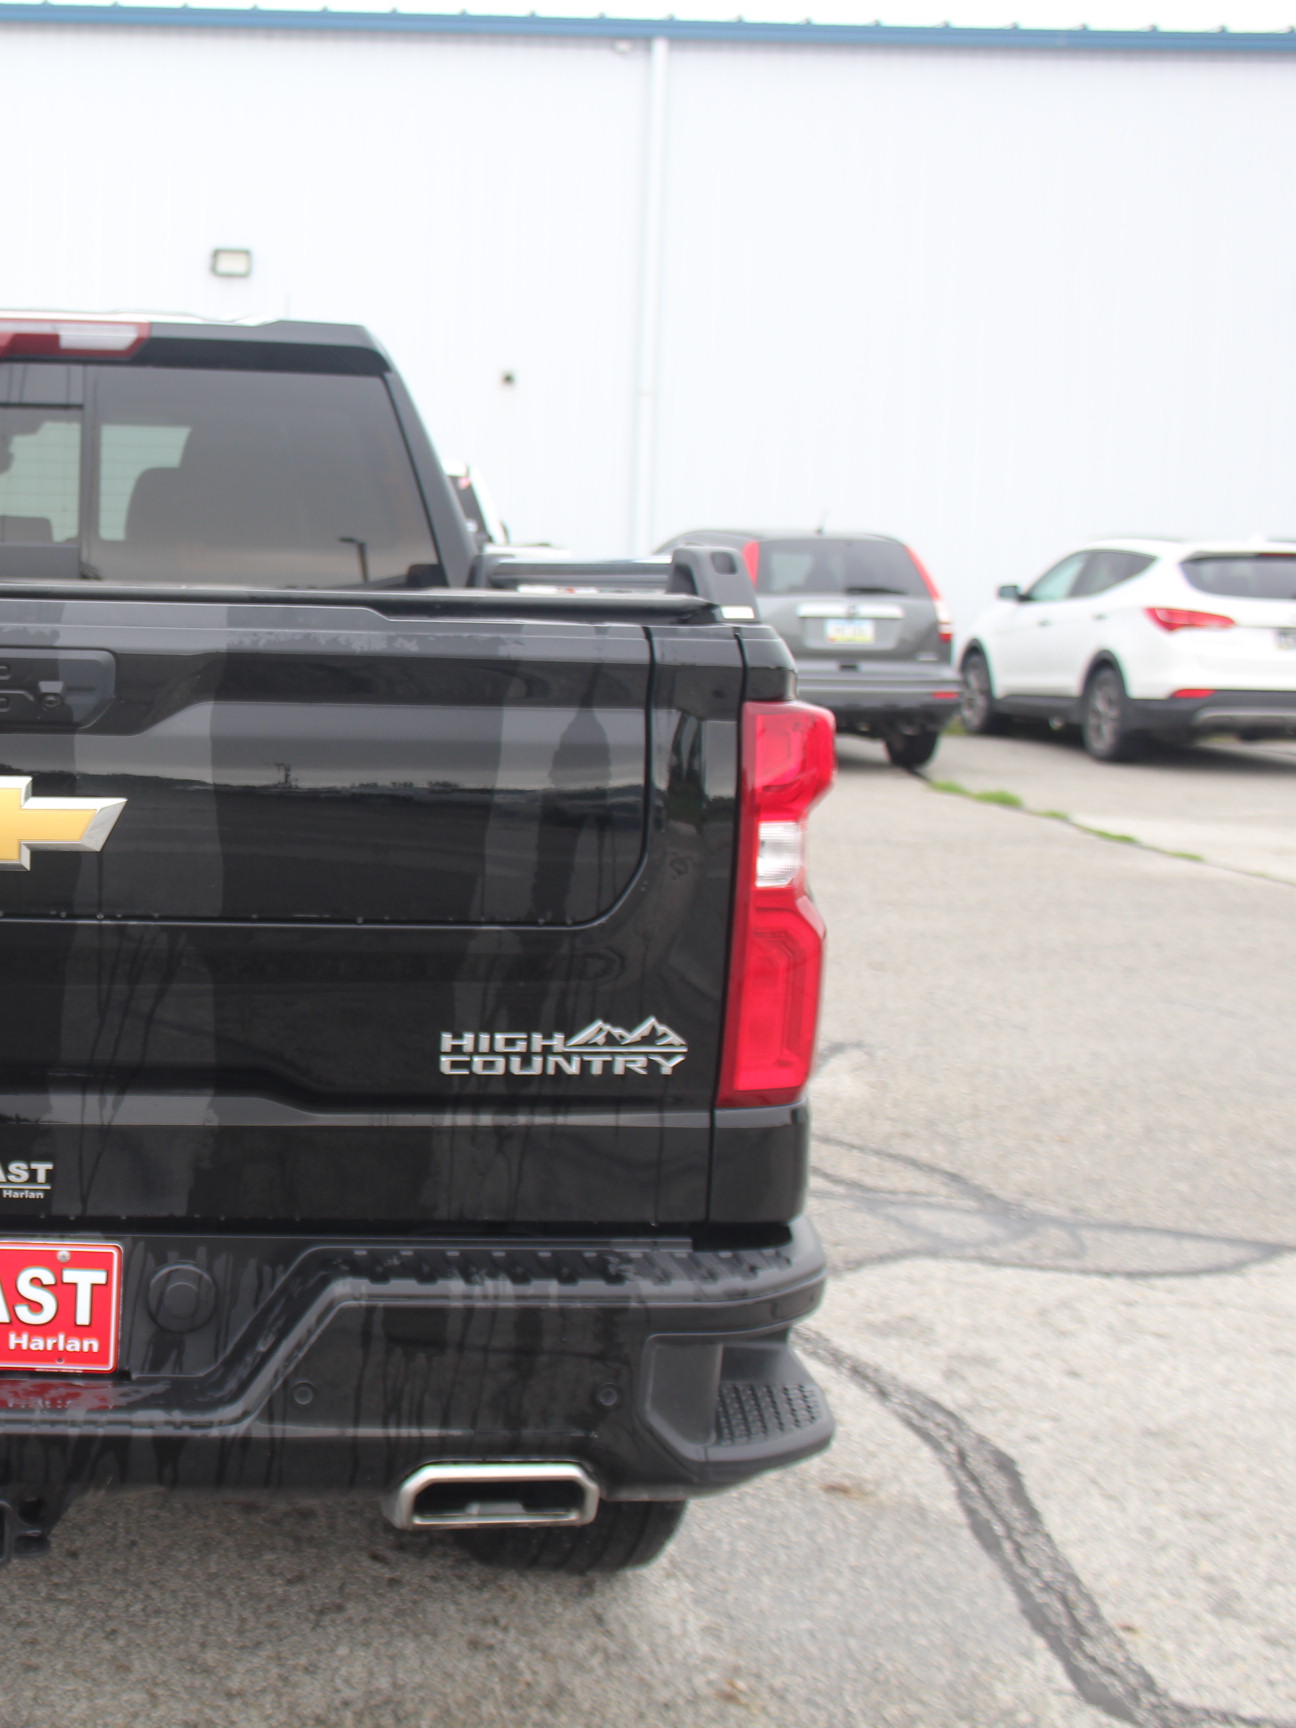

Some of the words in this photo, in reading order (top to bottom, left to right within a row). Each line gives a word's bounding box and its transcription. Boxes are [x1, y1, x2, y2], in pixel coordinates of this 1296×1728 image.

[440, 1032, 565, 1053] HIGH
[439, 1055, 686, 1075] COUNTRY
[2, 1189, 44, 1200] Harlan
[7, 1332, 100, 1353] Harlan
